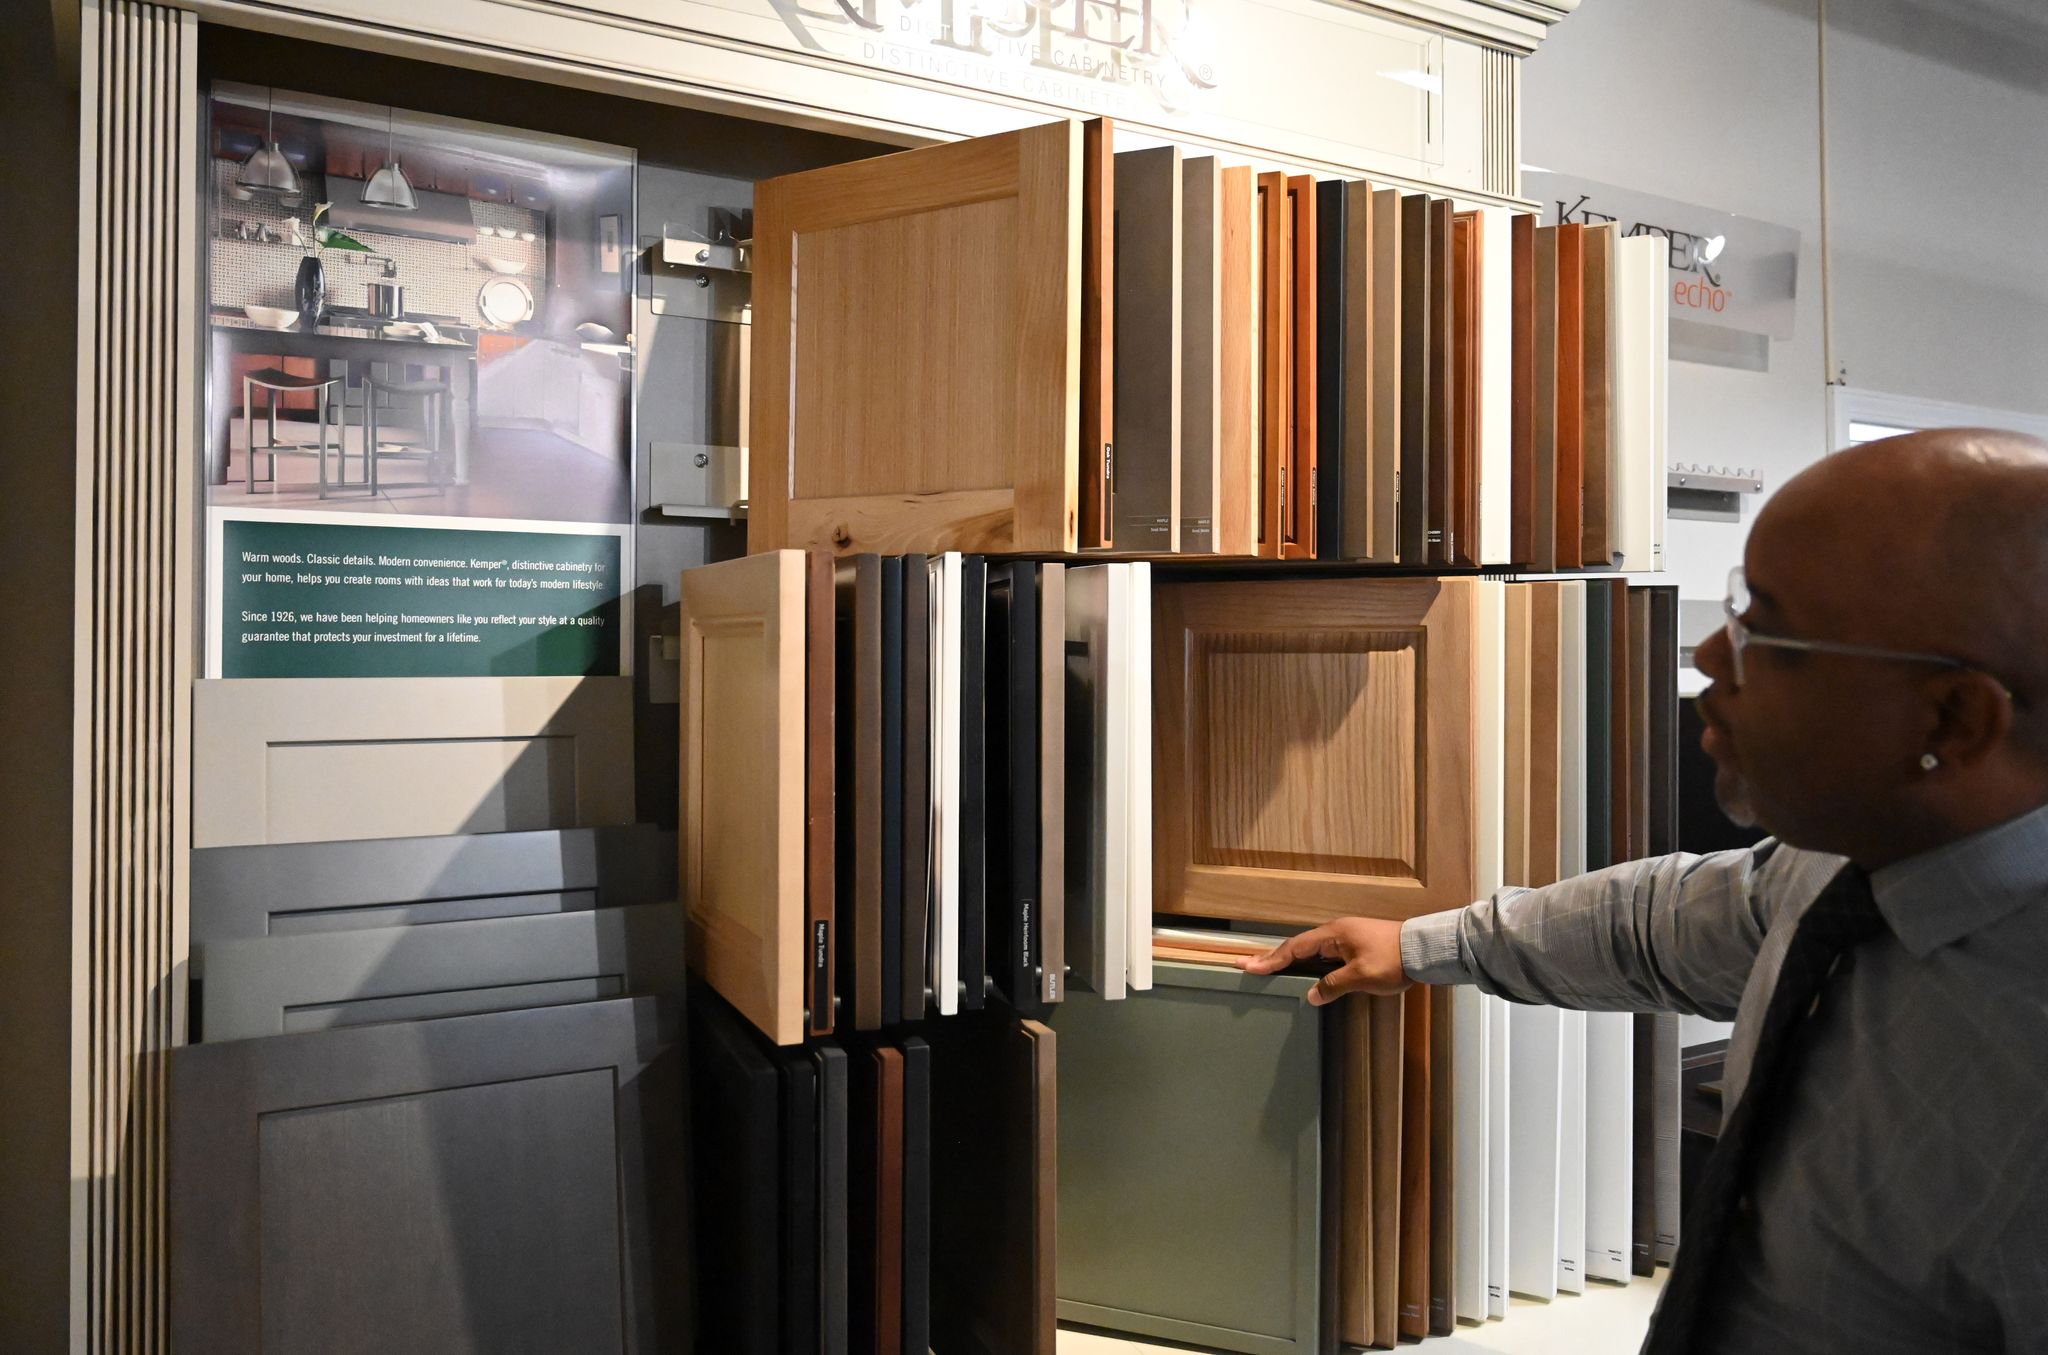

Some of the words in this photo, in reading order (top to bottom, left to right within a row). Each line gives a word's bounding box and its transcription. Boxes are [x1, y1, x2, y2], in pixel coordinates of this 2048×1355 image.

[1054, 50, 1166, 88] CABINETRY
[1674, 277, 1726, 312] echo
[242, 552, 269, 562] Warm
[272, 554, 304, 563] woods.
[307, 554, 340, 564] Classic
[343, 555, 375, 566] details.
[379, 556, 410, 566] Modern
[414, 558, 468, 568] convenience.
[512, 561, 554, 570] distinctive
[556, 562, 592, 573] cabinetry
[595, 563, 605, 572] for
[242, 573, 262, 583] your
[266, 572, 294, 584] home,
[297, 573, 322, 585] helps
[325, 576, 340, 585] you
[344, 575, 372, 584] create
[375, 577, 401, 585] rooms
[405, 576, 423, 585] with
[427, 576, 449, 586] ideas
[452, 577, 470, 586] that
[473, 578, 492, 587] work
[496, 578, 506, 587] for
[540, 580, 570, 588] modern
[242, 611, 267, 622] Since
[271, 612, 296, 623] 1926,
[300, 614, 313, 622] we
[316, 612, 338, 622] have
[341, 613, 362, 622] been
[366, 613, 398, 624] helping
[401, 613, 454, 623] homeowners
[457, 614, 471, 624] like
[474, 616, 488, 625] you
[491, 615, 516, 624] reflect
[519, 616, 536, 626] your
[538, 616, 556, 626] style
[578, 616, 605, 627] quality
[242, 632, 289, 643] guarantee
[292, 632, 311, 641] that
[314, 632, 350, 643] protects
[352, 634, 371, 643] your
[374, 632, 422, 642] investment
[425, 632, 436, 642] for
[439, 634, 444, 642] a
[447, 633, 480, 642] lifetime.
[817, 923, 825, 943] Maple
